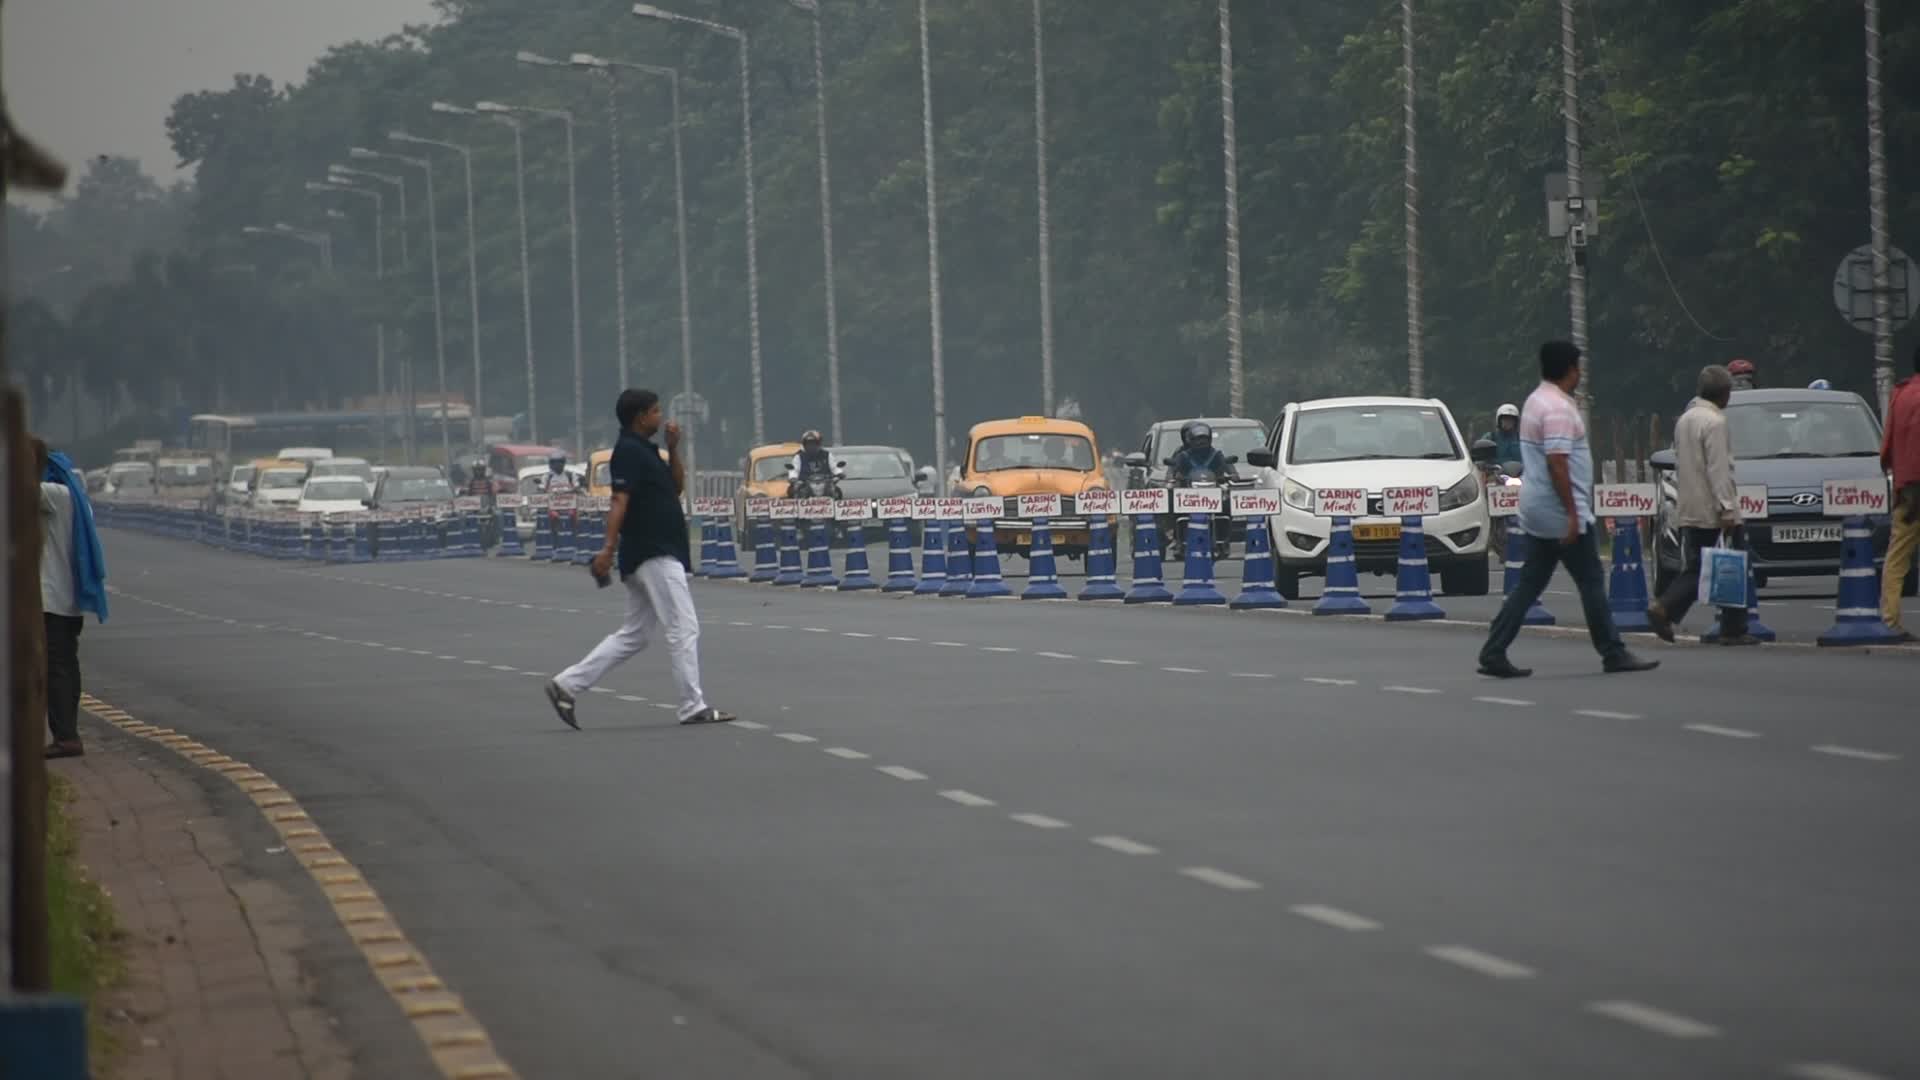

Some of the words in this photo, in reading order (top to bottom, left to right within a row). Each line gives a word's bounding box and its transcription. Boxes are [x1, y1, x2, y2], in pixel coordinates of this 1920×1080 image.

[1078, 490, 1116, 501] CARING
[1124, 490, 1163, 500] CARING
[1318, 490, 1362, 499] CARING
[1386, 487, 1434, 499] CARING
[1020, 494, 1057, 504] CARING
[1025, 504, 1053, 514] Minds
[1083, 500, 1112, 511] Minds
[1129, 500, 1159, 511] Minds
[1323, 500, 1357, 513] Minds
[1393, 499, 1429, 513] Minds
